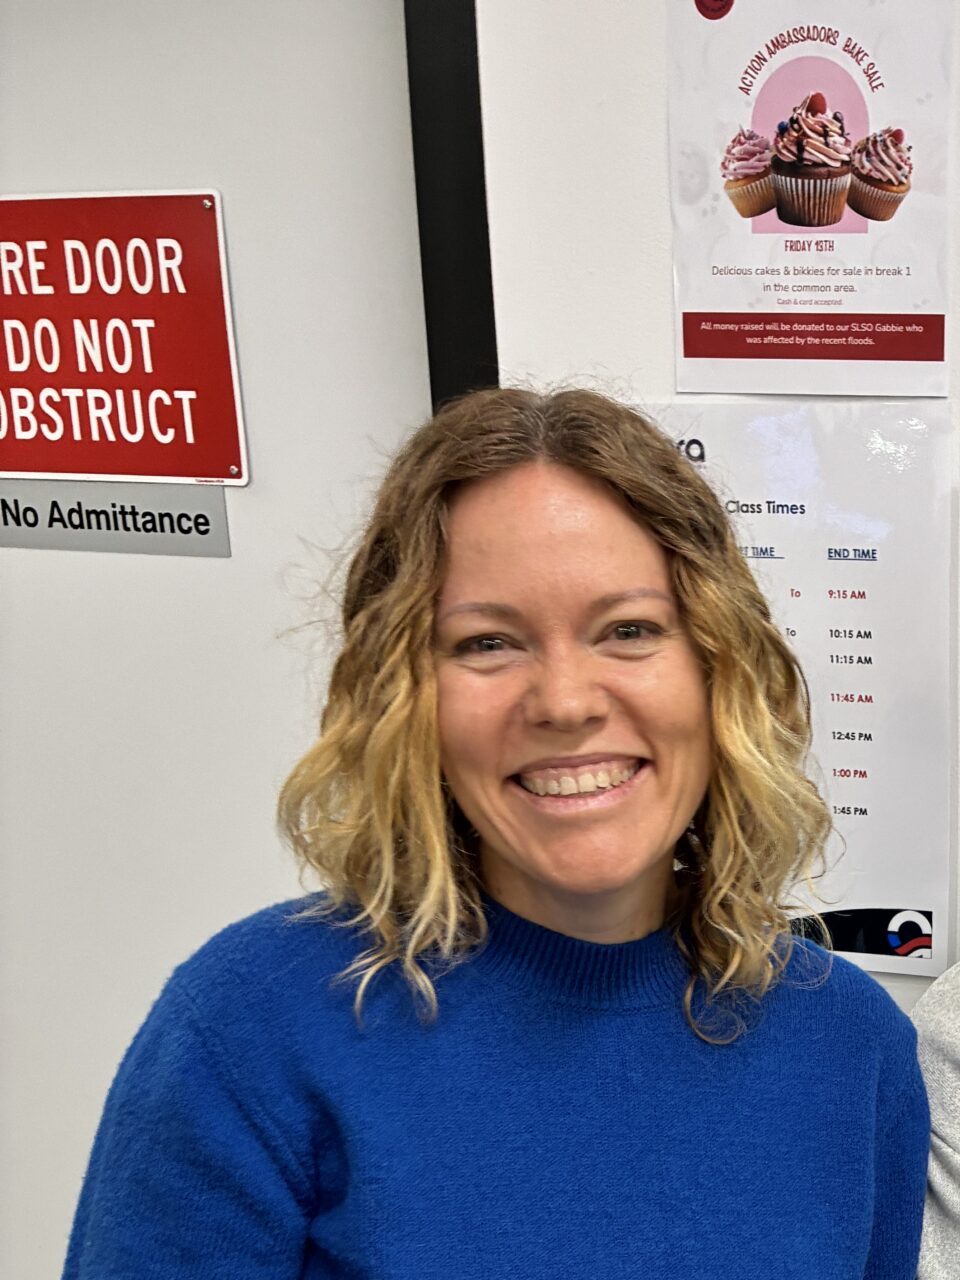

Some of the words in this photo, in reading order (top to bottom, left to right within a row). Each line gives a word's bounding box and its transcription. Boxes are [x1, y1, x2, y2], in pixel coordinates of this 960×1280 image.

[738, 51, 768, 96] ACTION
[765, 25, 840, 58] AMBASSADORS
[842, 37, 869, 66] BAKE
[863, 62, 885, 93] SALE
[784, 239, 813, 251] FRIDAY
[63, 238, 186, 295] DOOR
[712, 266, 753, 276] Delicious
[755, 266, 781, 276] cakes
[783, 266, 791, 276] &
[793, 266, 825, 276] bikkies
[827, 266, 841, 276] for
[842, 266, 862, 276] sale
[864, 266, 873, 276] in
[875, 266, 903, 276] break
[905, 266, 912, 276] 1
[763, 283, 772, 292] in
[774, 283, 789, 292] the
[792, 284, 831, 292] common
[834, 284, 857, 293] area.
[700, 322, 712, 330] All
[713, 323, 739, 331] money
[740, 322, 764, 330] raised
[765, 322, 779, 330] will
[780, 322, 791, 331] be
[792, 322, 824, 331] donated
[826, 323, 834, 331] to
[851, 323, 874, 332] SLSO
[875, 323, 904, 332] Gabbie
[905, 324, 924, 332] who
[745, 336, 762, 344] was
[763, 335, 794, 344] affected
[796, 336, 805, 345] by
[807, 336, 820, 344] the
[848, 336, 875, 345] floods.
[3, 318, 60, 373] DO
[73, 318, 155, 373] NOT
[0, 387, 197, 444] BSTRUCT
[726, 500, 762, 513] Class
[765, 500, 806, 514] Times
[0, 498, 39, 528] No
[48, 500, 211, 536] Admittance
[752, 547, 775, 557] TIME
[827, 548, 850, 559] END
[853, 549, 877, 560] TIME
[790, 588, 801, 597] To
[828, 589, 847, 599] 9:15
[850, 590, 866, 599] AM
[786, 627, 796, 637] To
[829, 629, 854, 639] 10:15
[856, 630, 872, 639] AM
[830, 654, 854, 664] 11:15
[856, 656, 873, 665] AM
[831, 693, 855, 702] 11:45
[857, 694, 873, 703] AM
[832, 731, 856, 740] 12:45
[858, 732, 873, 741] PM
[833, 768, 851, 778] 1:00
[853, 769, 868, 778] PM
[833, 806, 852, 815] 1:45
[854, 807, 868, 816] PM
